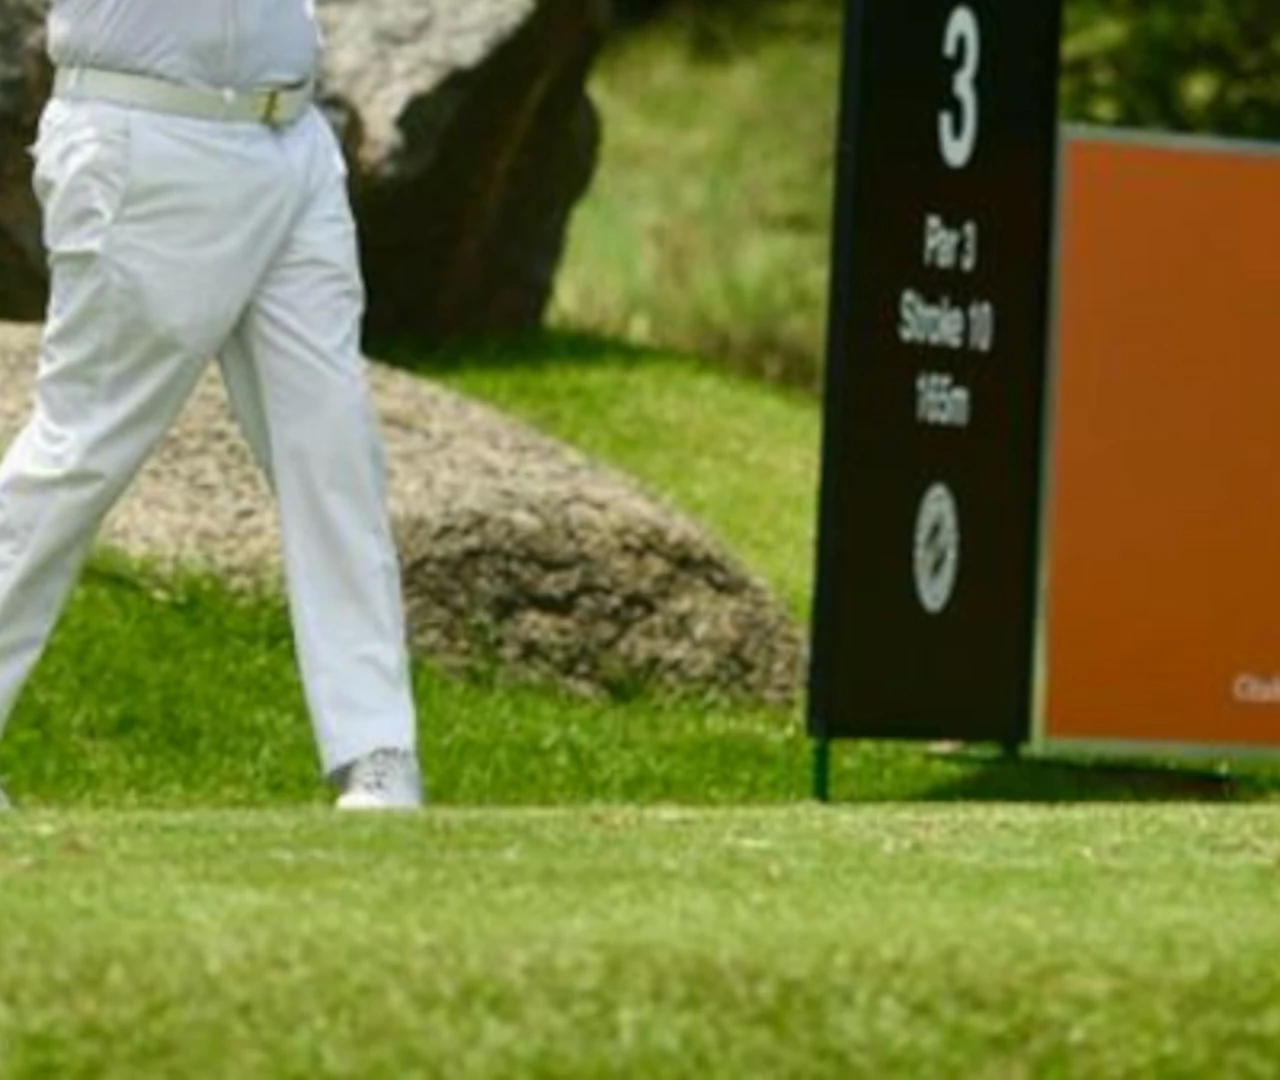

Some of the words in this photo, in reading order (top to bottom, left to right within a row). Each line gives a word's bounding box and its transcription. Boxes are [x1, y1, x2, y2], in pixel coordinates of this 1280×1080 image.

[938, 5, 980, 169] 3
[923, 214, 961, 268] Par
[960, 219, 978, 272] 3
[899, 288, 965, 349] Stroke
